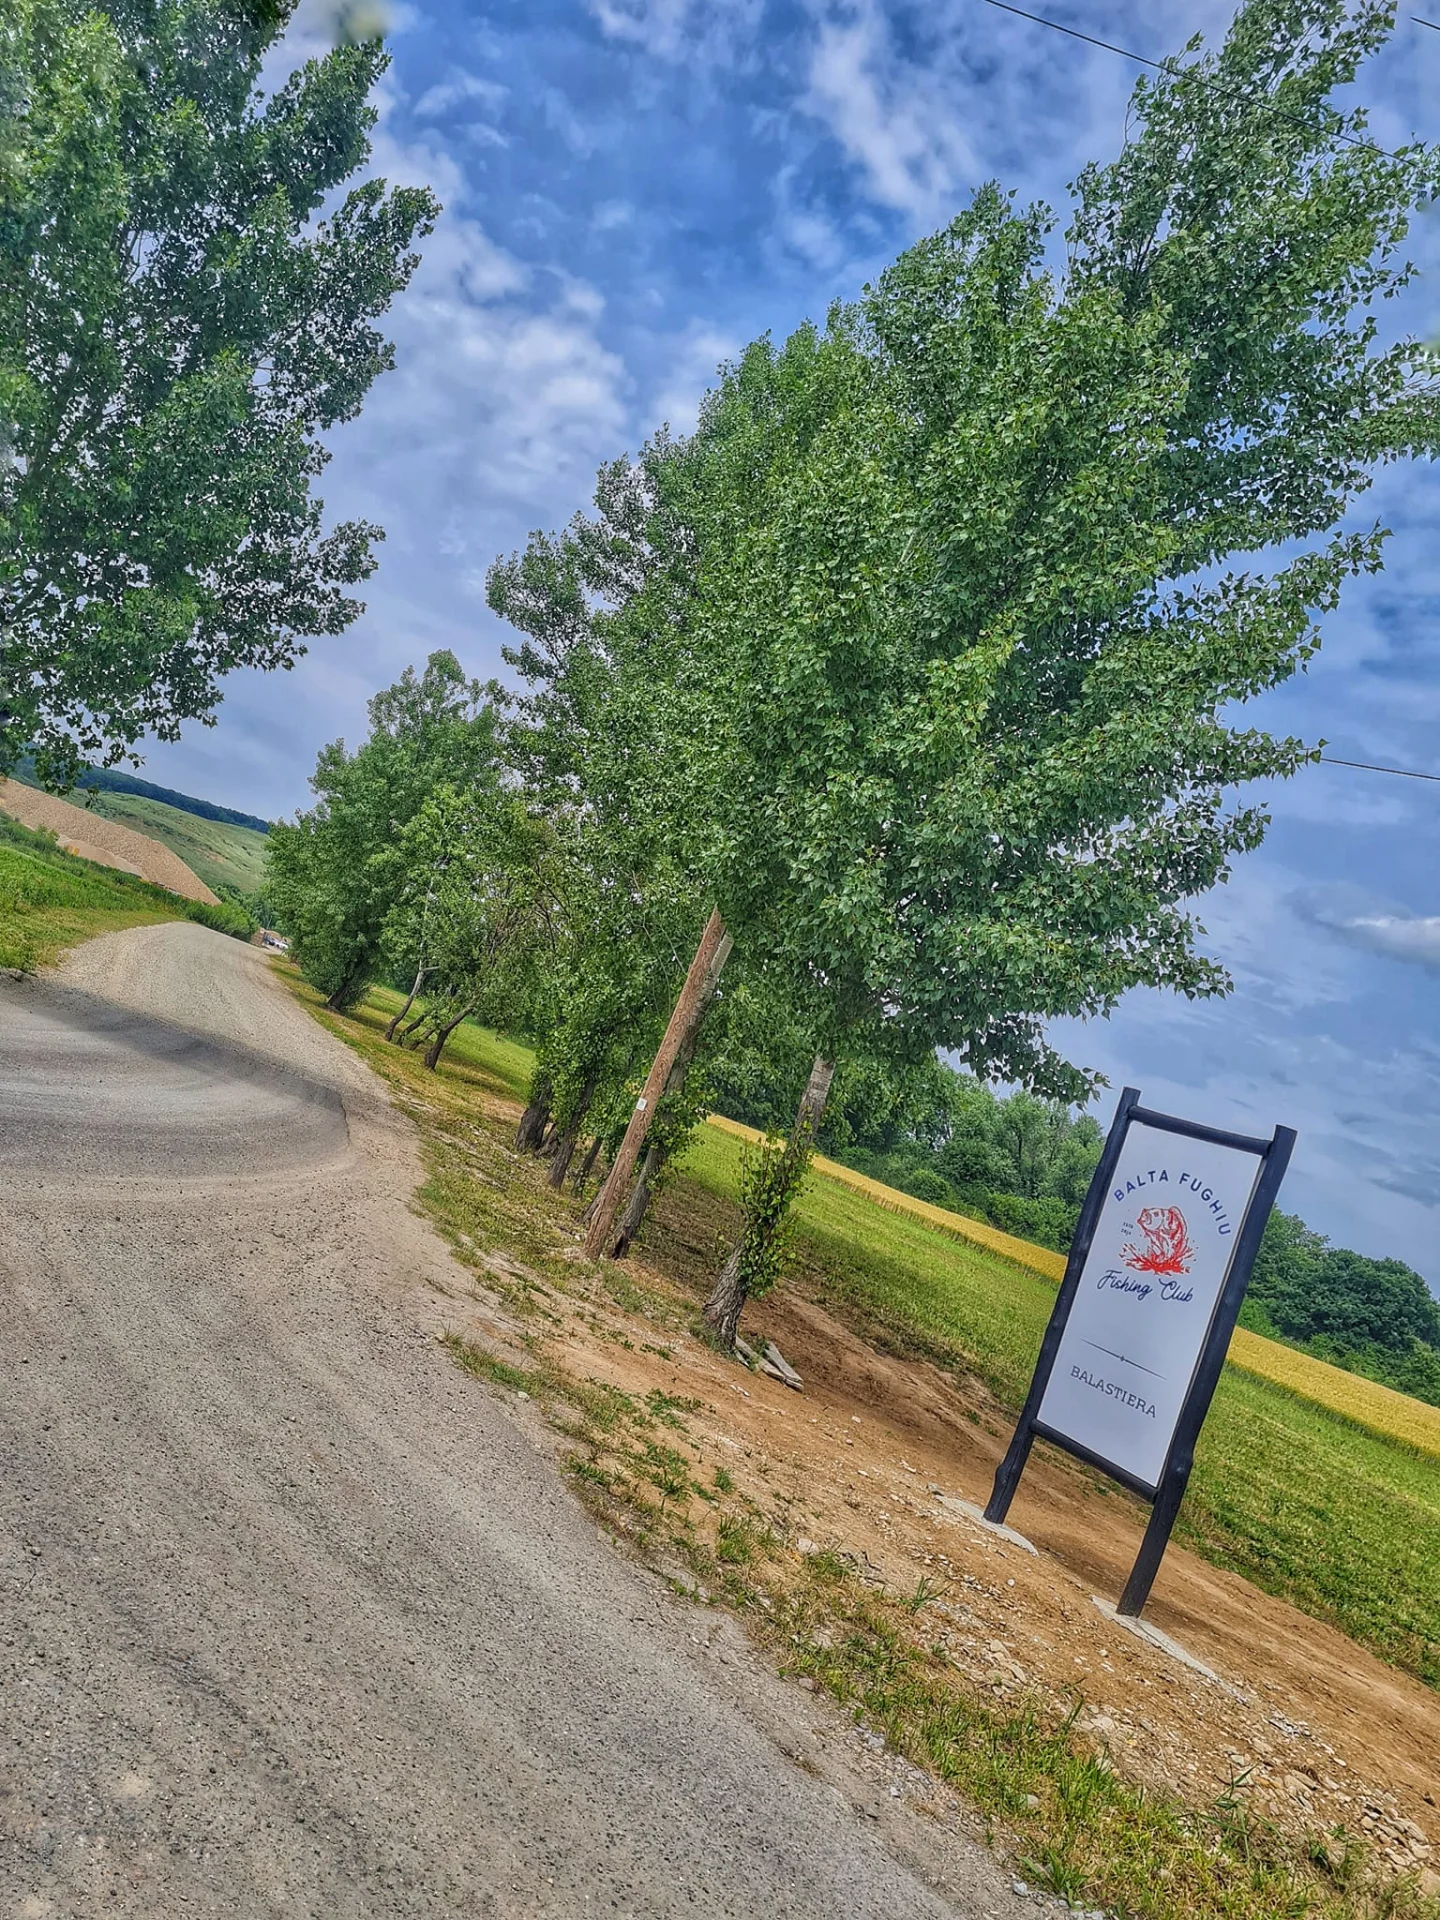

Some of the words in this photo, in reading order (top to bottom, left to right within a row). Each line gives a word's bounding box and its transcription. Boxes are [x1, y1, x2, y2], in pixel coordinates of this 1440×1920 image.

[1114, 1169, 1169, 1202] BALTA
[1179, 1172, 1231, 1236] FUGHIU
[1097, 1269, 1153, 1301] Fishing
[1158, 1278, 1194, 1303] Club
[1070, 1365, 1156, 1418] BALASTIERA
